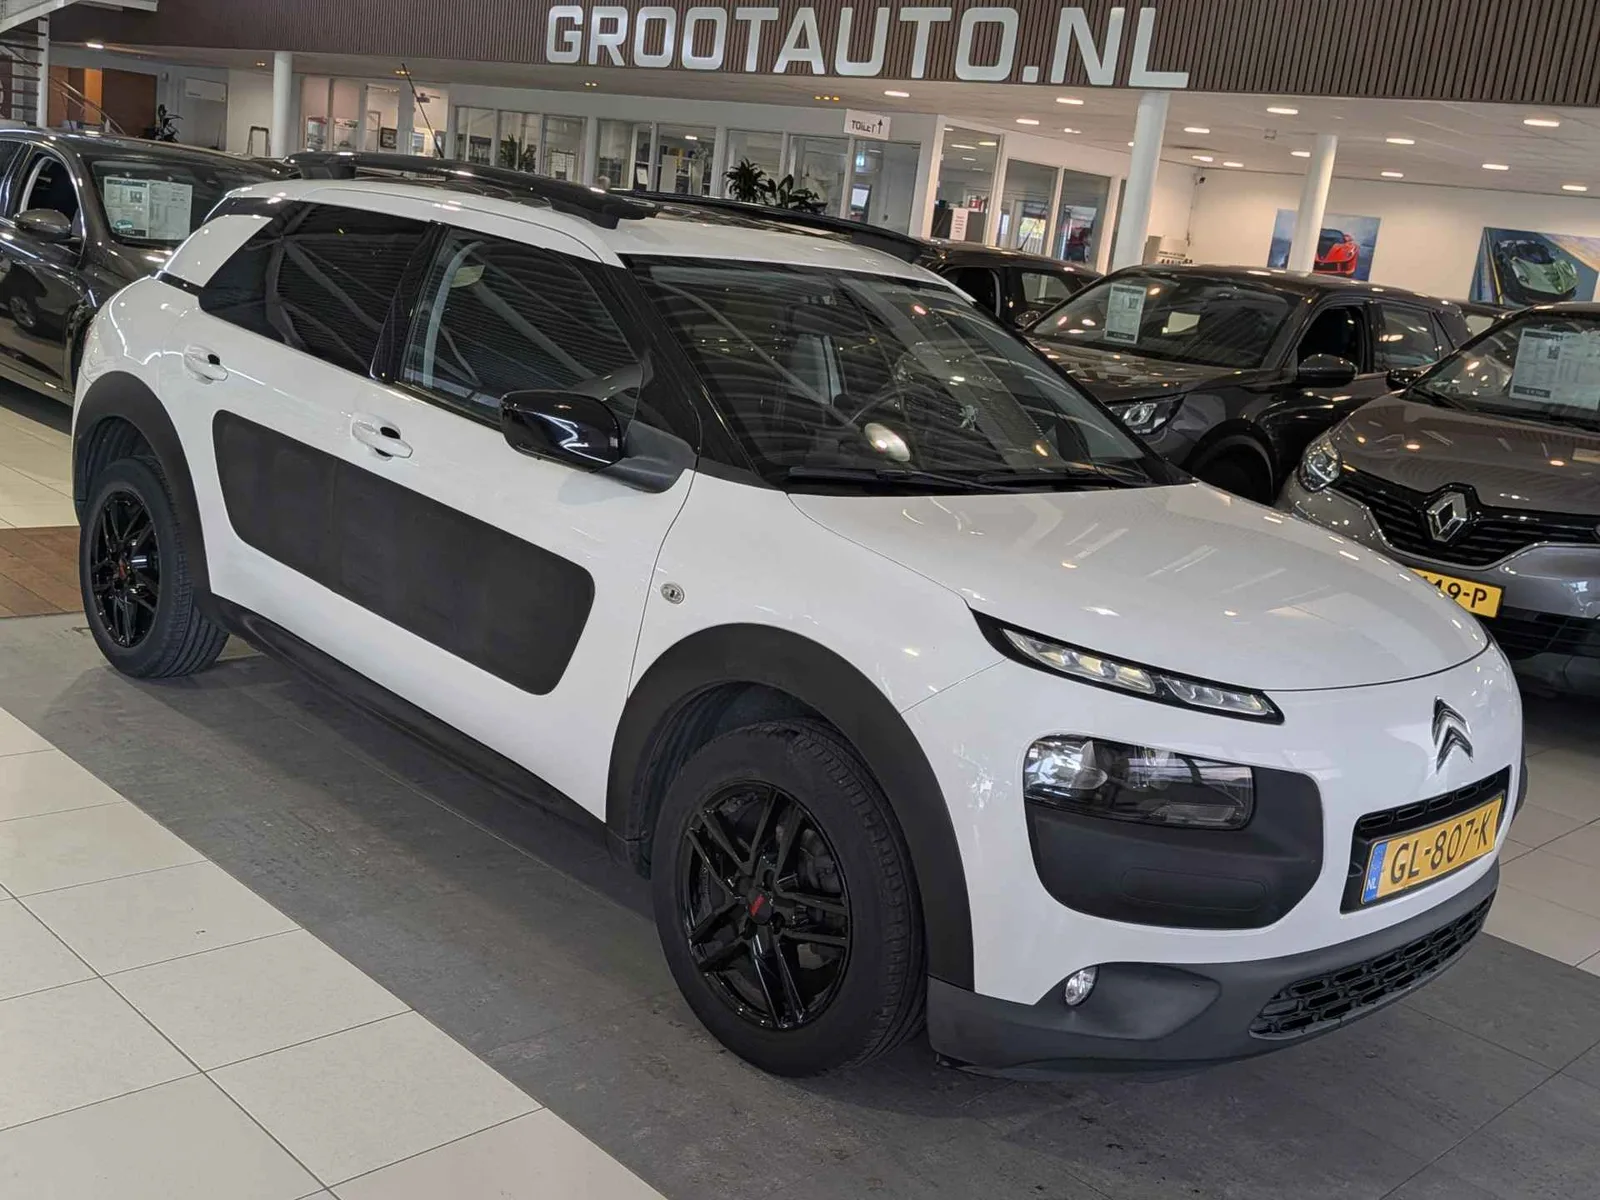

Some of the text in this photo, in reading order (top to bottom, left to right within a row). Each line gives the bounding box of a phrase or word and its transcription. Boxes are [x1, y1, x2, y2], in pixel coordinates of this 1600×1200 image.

[546, 5, 1189, 88] GROOTAUTO.NL
[1423, 576, 1487, 608] 9-P
[1390, 809, 1493, 885] GL-807-K
